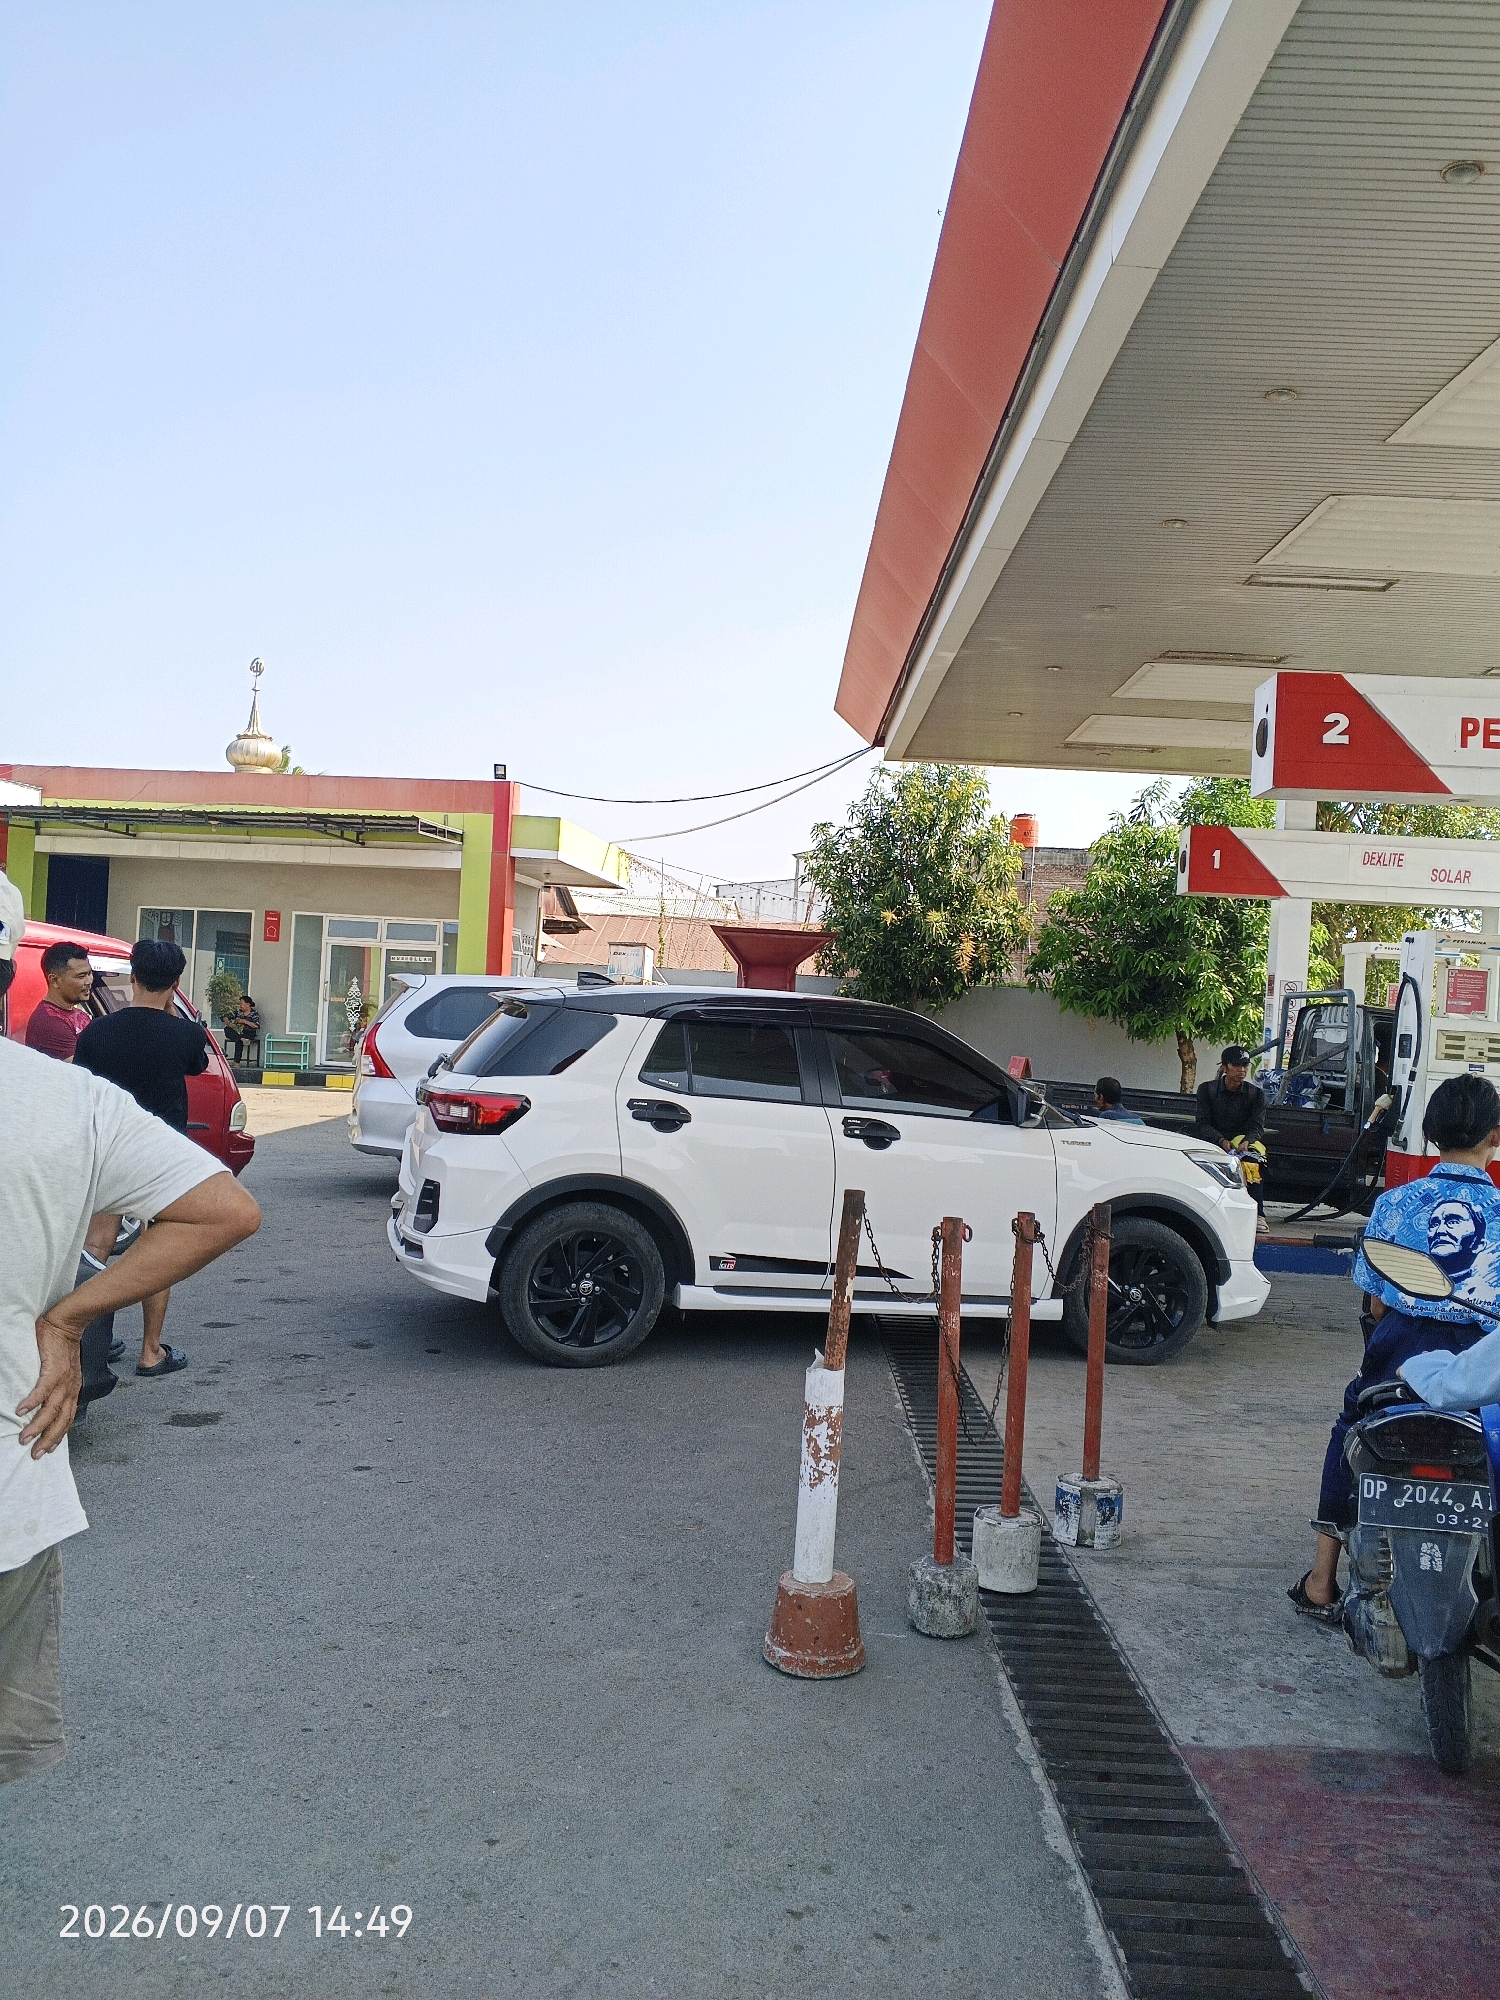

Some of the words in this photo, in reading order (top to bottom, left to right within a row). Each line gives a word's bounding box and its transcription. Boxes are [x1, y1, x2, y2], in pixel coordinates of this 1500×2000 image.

[1322, 712, 1350, 745] 2
[1211, 849, 1221, 869] 1
[1362, 851, 1405, 868] DEXLITE
[1430, 868, 1472, 884] SOLAR
[1363, 1479, 1388, 1500] DP
[1402, 1484, 1453, 1506] 2044
